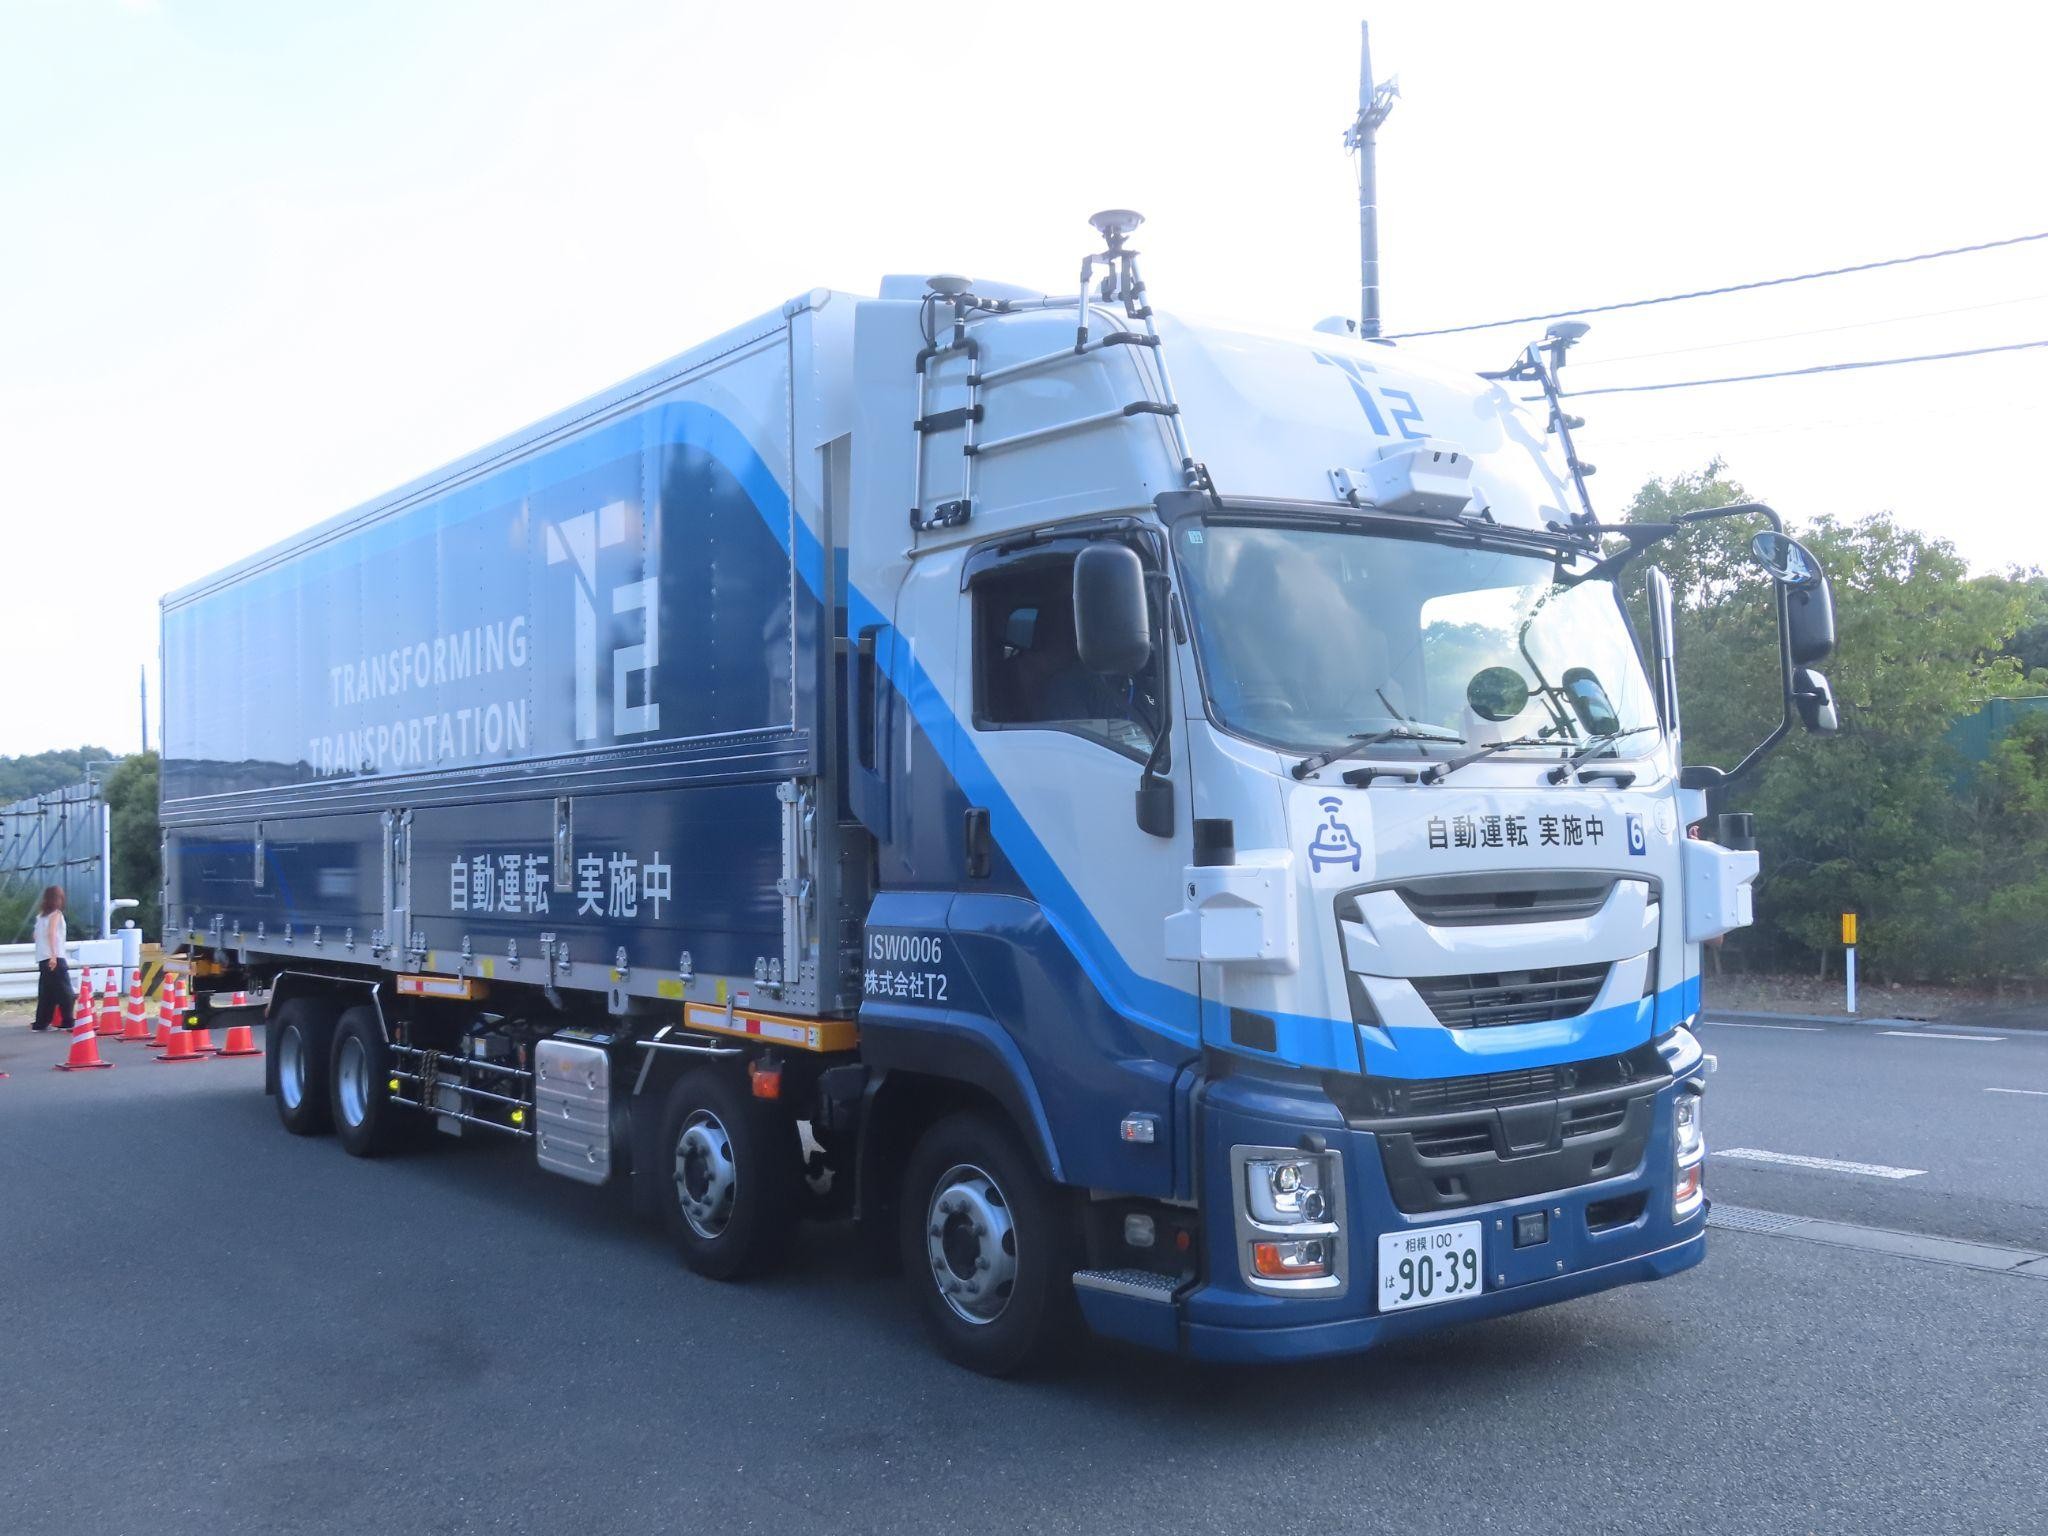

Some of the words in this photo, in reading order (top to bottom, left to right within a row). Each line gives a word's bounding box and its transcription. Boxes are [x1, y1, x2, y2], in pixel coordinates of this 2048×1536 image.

[1311, 351, 1432, 439] T2
[547, 500, 660, 741] T2
[331, 615, 527, 708] TRANSFORMING
[309, 699, 527, 778] TRANSPORTATION
[1427, 815, 1529, 849] 自動運転
[1538, 814, 1604, 846] 実施中
[1631, 818, 1643, 850] 6
[451, 853, 549, 914] 自動運転
[577, 851, 671, 919] 実施中
[868, 934, 942, 963] ISW0006
[864, 969, 948, 1000] 株式会社T2
[1398, 1248, 1477, 1301] 90-39
